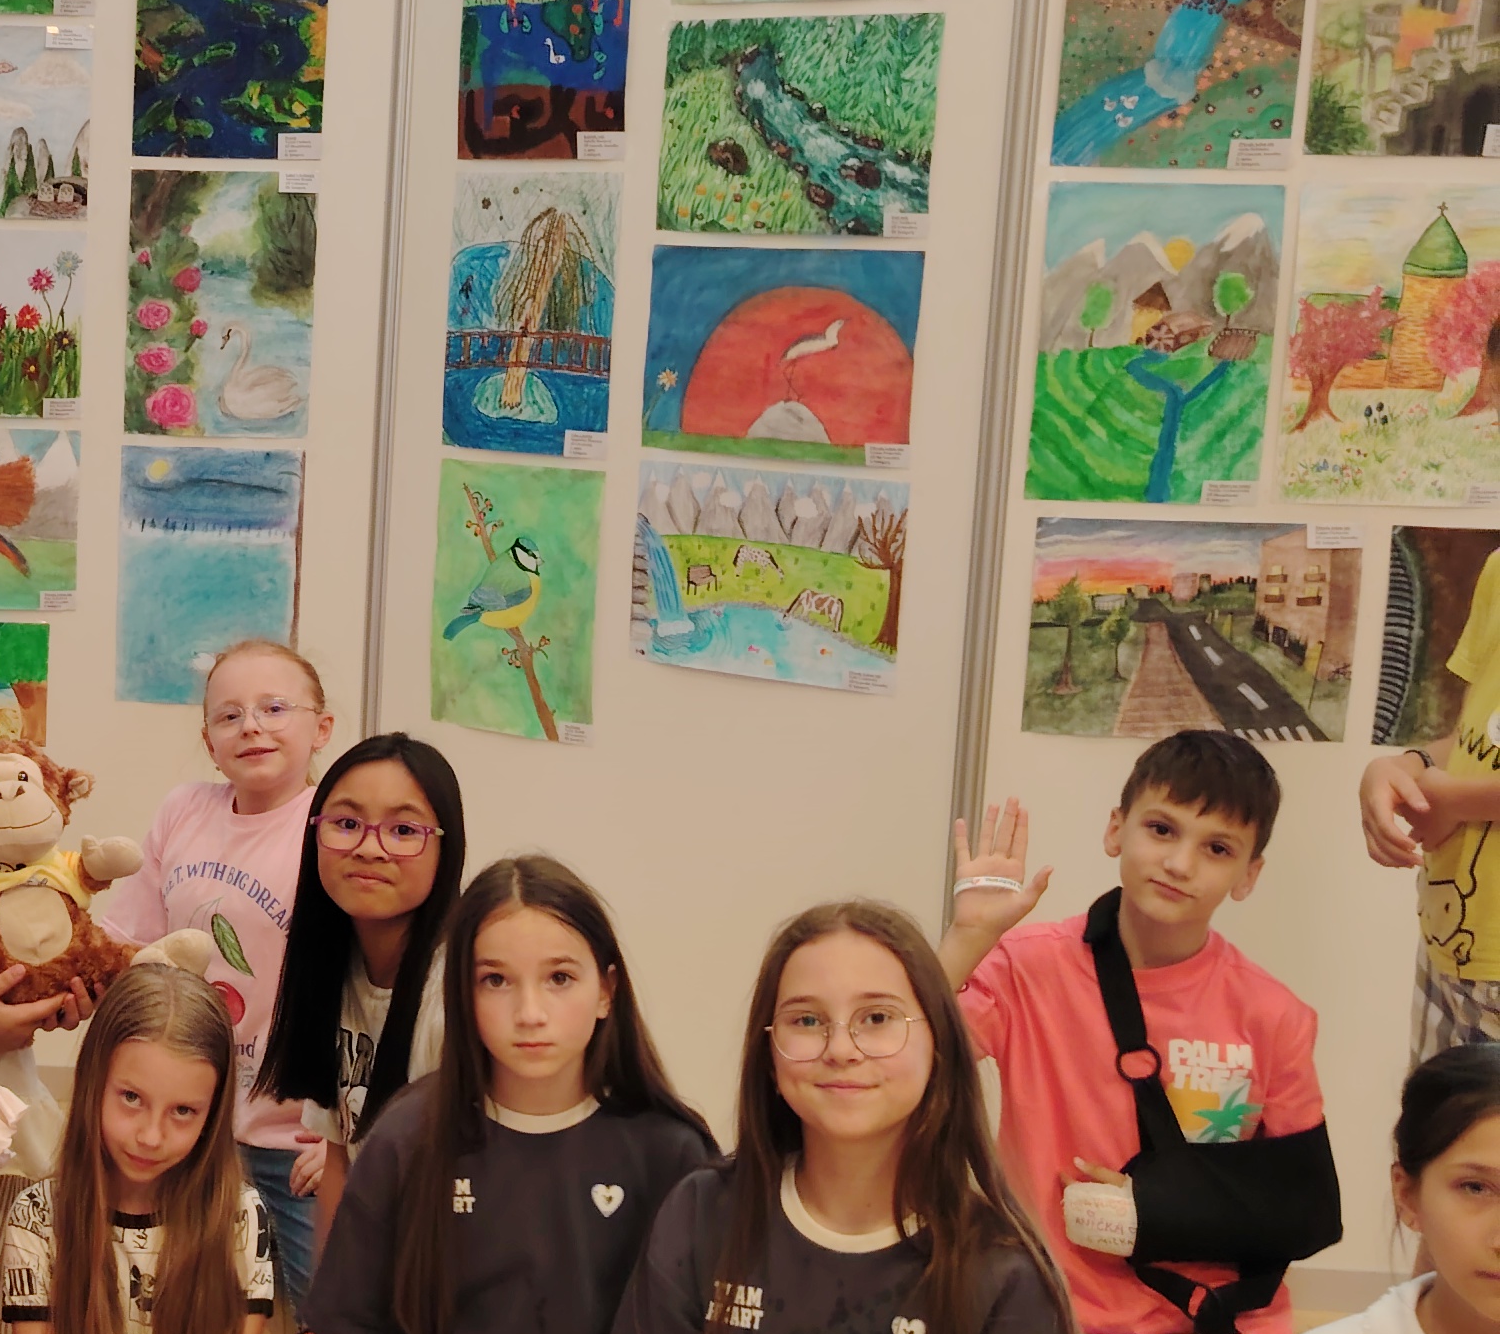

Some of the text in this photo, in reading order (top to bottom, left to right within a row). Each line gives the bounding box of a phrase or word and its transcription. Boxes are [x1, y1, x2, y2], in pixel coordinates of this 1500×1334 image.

[187, 861, 227, 882] WITH
[226, 866, 250, 891] BIG
[1168, 1038, 1253, 1070] PALM
